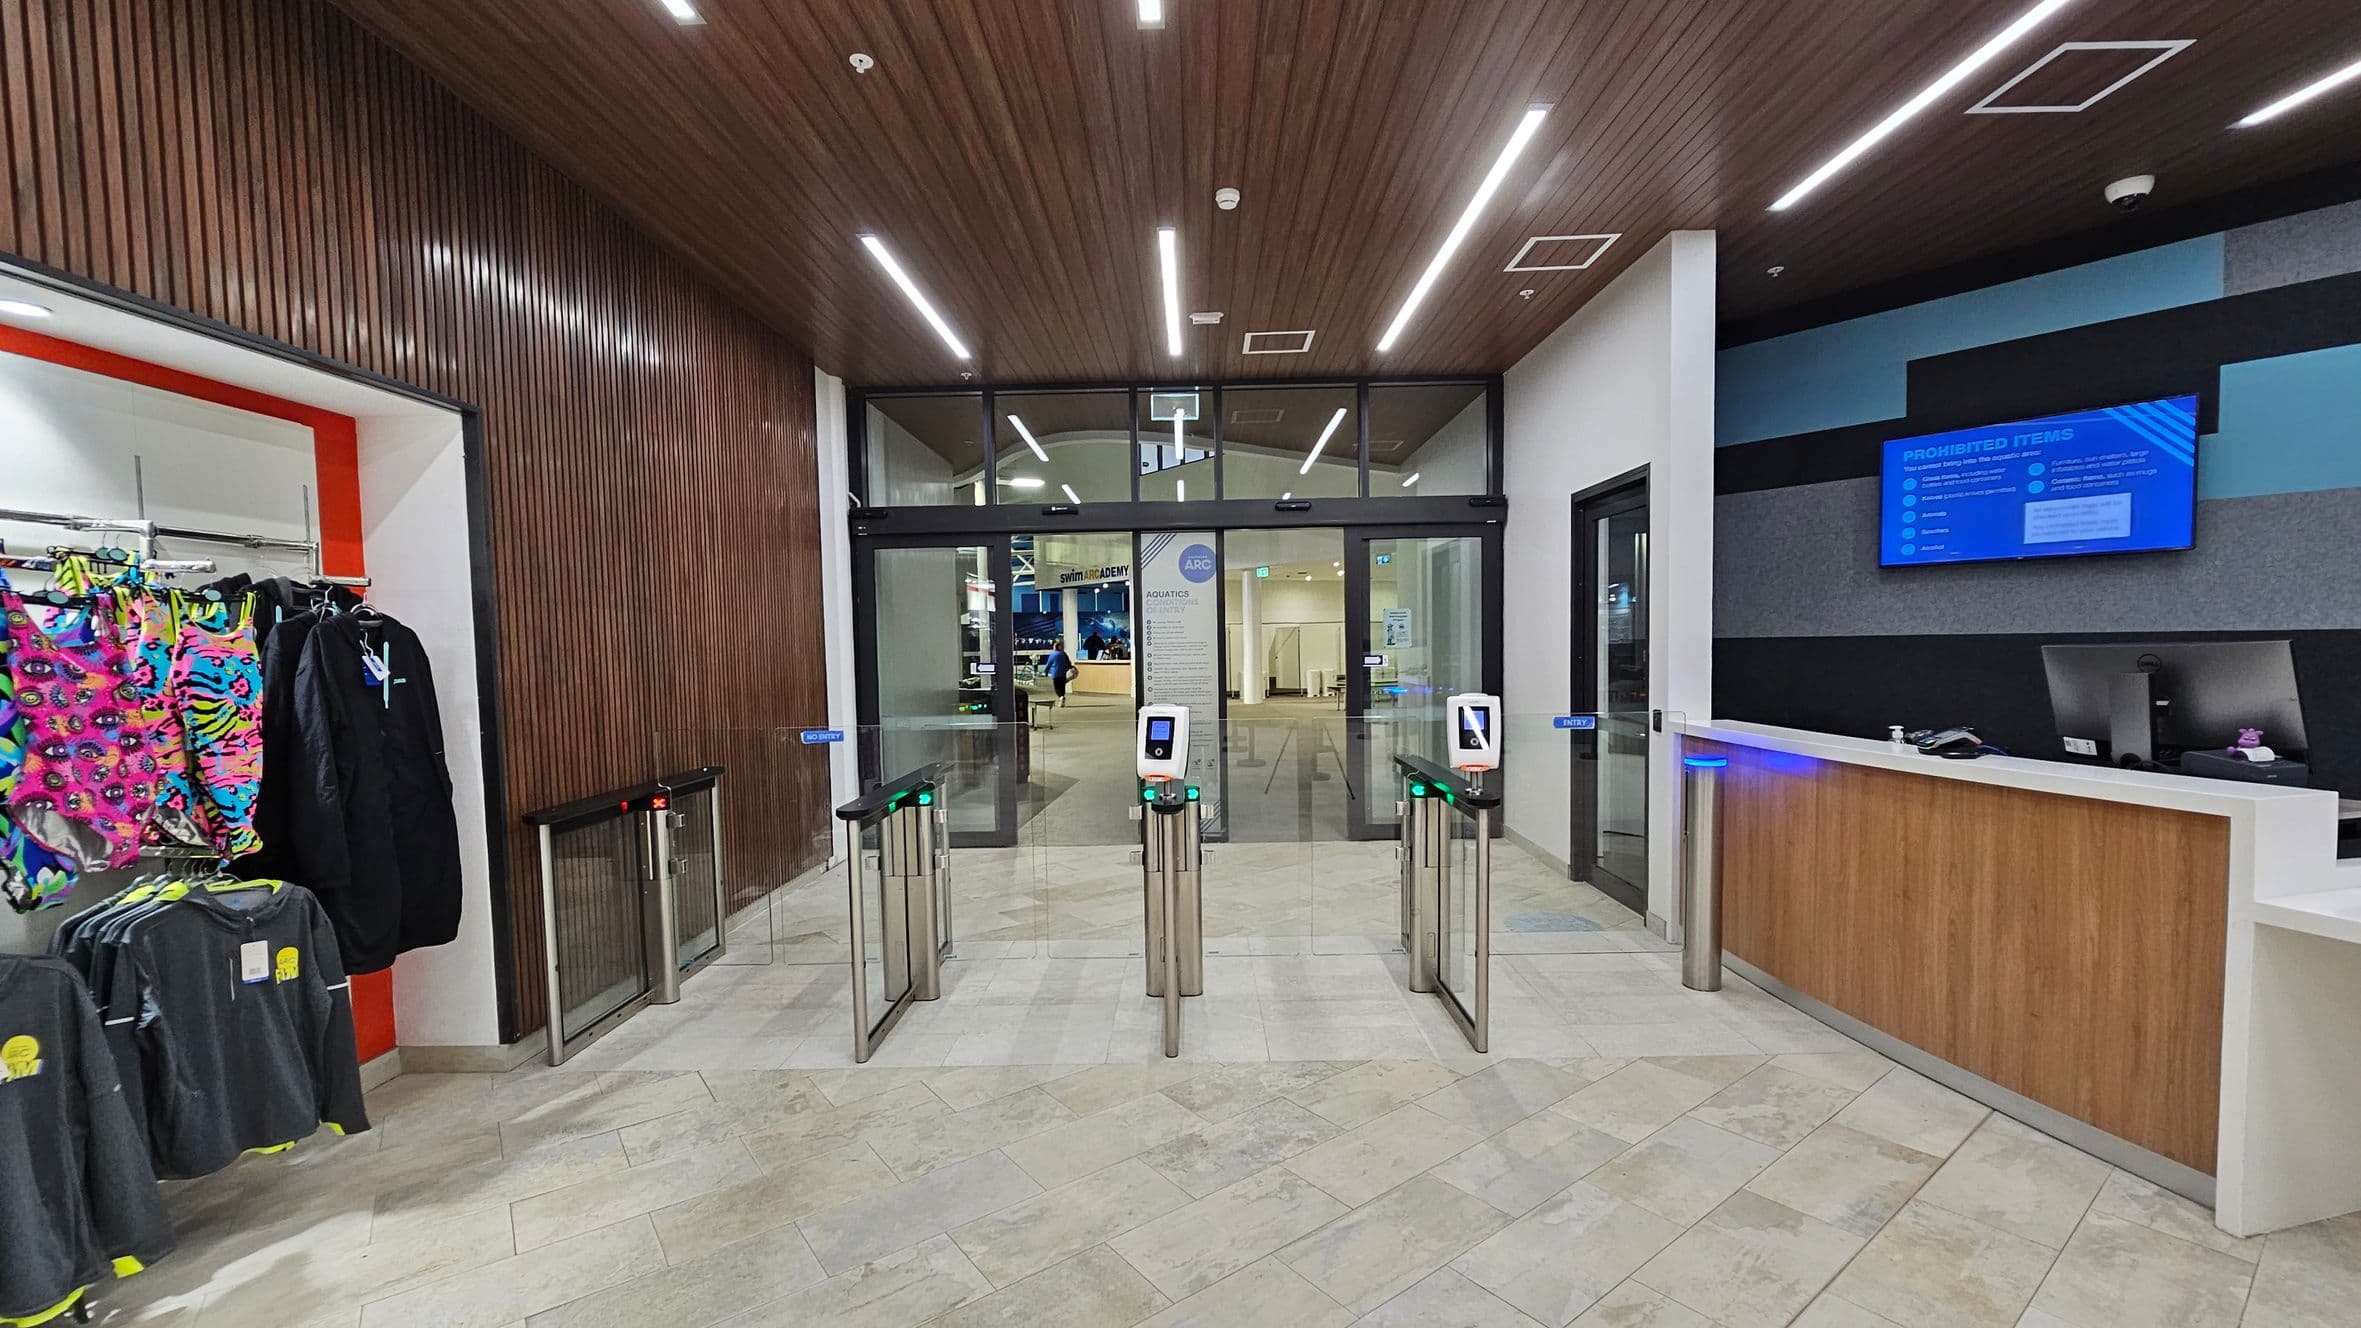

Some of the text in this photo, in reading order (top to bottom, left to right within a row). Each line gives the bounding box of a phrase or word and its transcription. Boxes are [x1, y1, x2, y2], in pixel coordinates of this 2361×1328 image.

[1903, 428, 2075, 462] PROHIBITED ITEMS
[1917, 462, 1942, 471] cannot
[1943, 460, 1962, 468] bring
[1991, 453, 2020, 462] aquatic
[1184, 559, 1212, 570] ARC
[1146, 590, 1189, 598] AQUATICS
[1146, 598, 1199, 606] CONDITIONS
